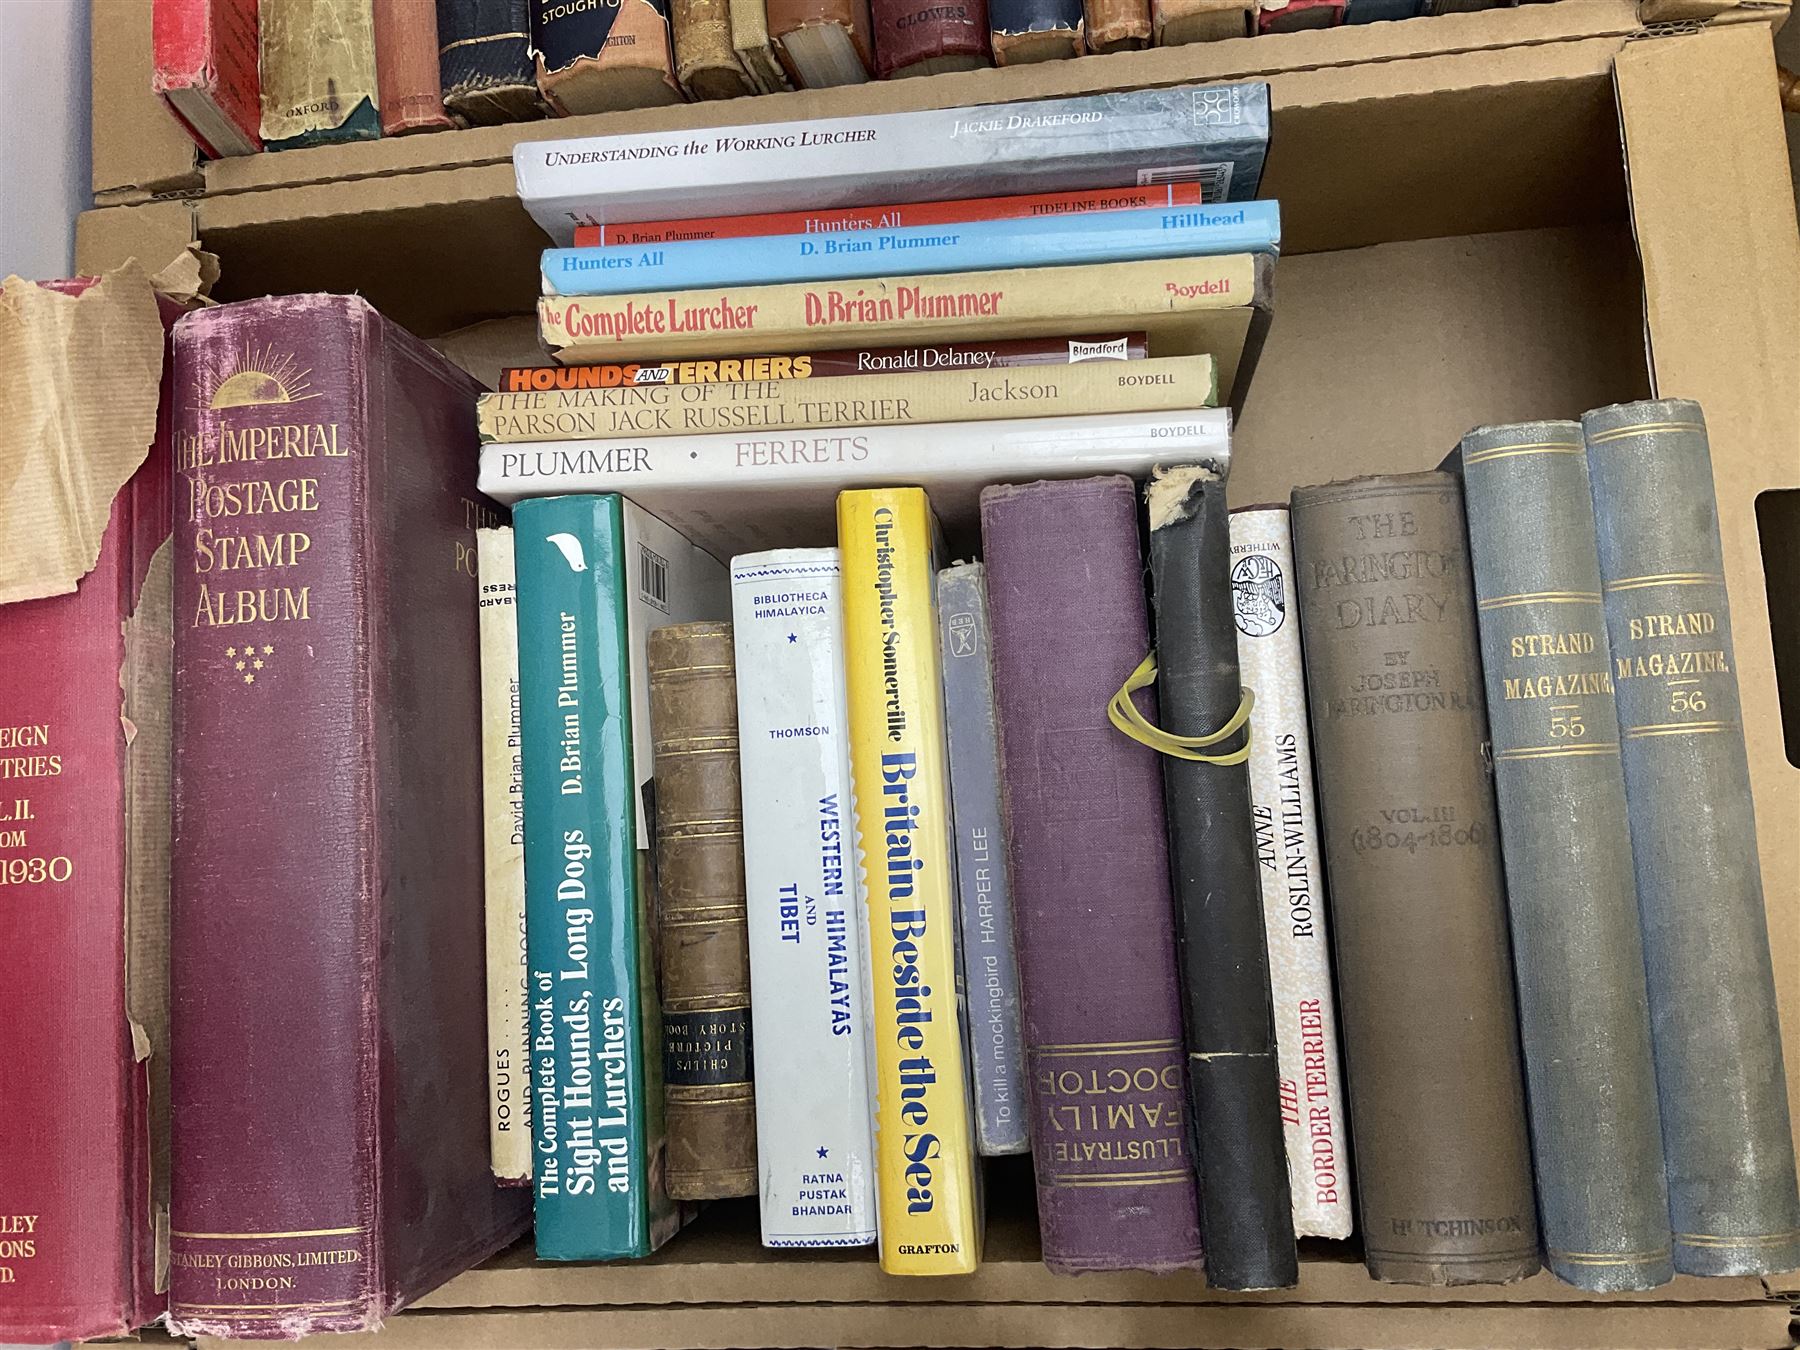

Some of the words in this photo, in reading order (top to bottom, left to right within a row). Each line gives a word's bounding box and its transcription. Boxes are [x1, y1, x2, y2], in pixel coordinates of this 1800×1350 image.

[896, 6, 966, 29] CLOWES
[286, 102, 339, 118] OXFORD
[951, 118, 1003, 138] JACKIE
[1006, 111, 1102, 130] DRAKEFORD
[544, 145, 678, 167] UNDERSTANDING
[684, 140, 708, 155] the
[714, 135, 795, 153] WORKING
[800, 128, 876, 147] LURCHER
[1030, 200, 1095, 215] TIDELINE
[1099, 196, 1146, 210] BOOKS
[1161, 210, 1245, 229] Hillhead
[616, 233, 628, 245] D.
[632, 231, 661, 243] Brian
[665, 229, 715, 241] Plummer
[805, 216, 873, 233] Hunters
[879, 211, 903, 227] All
[800, 241, 818, 255] D.
[825, 239, 872, 254] Brian
[878, 233, 960, 252] Plummer
[562, 255, 633, 272] Hunters
[638, 252, 664, 267] All
[897, 286, 1003, 321] Plummer
[1166, 279, 1230, 299] Boydell
[564, 302, 665, 341] Complete
[668, 297, 758, 333] Lurcher
[857, 350, 918, 370] Ronald
[922, 348, 996, 372] Delaney
[1073, 342, 1125, 356] Blandford
[510, 364, 641, 391] HOUNDS
[636, 368, 669, 381] AND
[660, 356, 813, 384] TERRIERS
[1118, 374, 1176, 387] BOYDELL
[494, 392, 547, 411] THE
[557, 386, 670, 408] MAKING
[680, 384, 713, 403] OF
[720, 381, 780, 401] THE
[968, 379, 1059, 403] Jackson
[494, 412, 596, 436] PARSON
[608, 409, 673, 432] JACK
[684, 404, 795, 429] RUSSELL
[797, 399, 912, 424] TERRIER
[1150, 425, 1207, 438] BOYDELL
[218, 420, 349, 465] IMPERIAL
[735, 436, 869, 467] FERRETS
[501, 447, 653, 478] PLUMMER
[189, 477, 320, 522] POSTAGE
[1347, 512, 1419, 541] THE
[195, 528, 311, 573] STAMP
[1229, 542, 1281, 555] WITHERBY
[873, 507, 895, 629] Christopher
[1311, 551, 1456, 590] FARINGTO
[192, 584, 311, 629] ALBUM
[479, 597, 517, 608] BARD
[753, 591, 828, 605] BIBLIOTHECA
[755, 605, 826, 619] HIMALAYICA
[1336, 592, 1453, 630] DIARY
[1630, 612, 1716, 641] STRAND
[558, 612, 580, 709] Plummer
[1383, 651, 1411, 667] BY
[1511, 633, 1595, 658] STRAND
[880, 630, 907, 744] Somerville
[1670, 690, 1707, 713] 56
[507, 678, 522, 748] Plummer
[1550, 716, 1586, 738] 55
[560, 714, 581, 772] Brian
[769, 726, 830, 739] THOMSON
[508, 753, 523, 795] Brian
[561, 773, 583, 795] D.
[509, 799, 525, 845] David
[881, 748, 924, 900] Britain
[1253, 804, 1277, 871] ANNE
[1275, 733, 1314, 938] ROSLIN-WILLIAMS
[819, 793, 844, 896] WESTERN
[972, 827, 989, 861] LEE
[0, 856, 73, 885] 1930
[557, 829, 593, 902] Dogs
[779, 883, 801, 943] TIBET
[805, 895, 817, 926] AND
[976, 868, 996, 943] HARPER
[560, 905, 594, 980] Long
[533, 971, 553, 984] of
[825, 910, 852, 1036] HIMALAYAS
[889, 906, 933, 1050] Beside
[534, 986, 556, 1052] Book
[983, 955, 1005, 1060] mockingbird
[700, 1022, 746, 1035] STORY
[562, 990, 595, 1113] Hounds,
[669, 1040, 732, 1053] PICTURE
[1299, 998, 1330, 1103] TERRIER
[596, 997, 629, 1128] Lurchers
[995, 1064, 1007, 1075] a
[497, 1048, 510, 1131] ROGUES
[897, 1055, 937, 1126] the
[993, 1078, 1009, 1102] kill
[1278, 1077, 1301, 1127] THE
[537, 1056, 560, 1158] Complete
[996, 1106, 1011, 1127] To
[1046, 1103, 1183, 1131] FAMILY
[566, 1118, 602, 1195] Sight
[597, 1134, 630, 1193] and
[1308, 1106, 1338, 1205] BORDER
[540, 1160, 559, 1198] The
[802, 1173, 844, 1184] RATNA
[903, 1131, 943, 1217] Sea
[799, 1189, 847, 1200] PUSTAK
[792, 1205, 852, 1216] BHANDAR
[228, 1253, 296, 1269] GIBBONS,
[898, 1244, 960, 1255] GRAFTON
